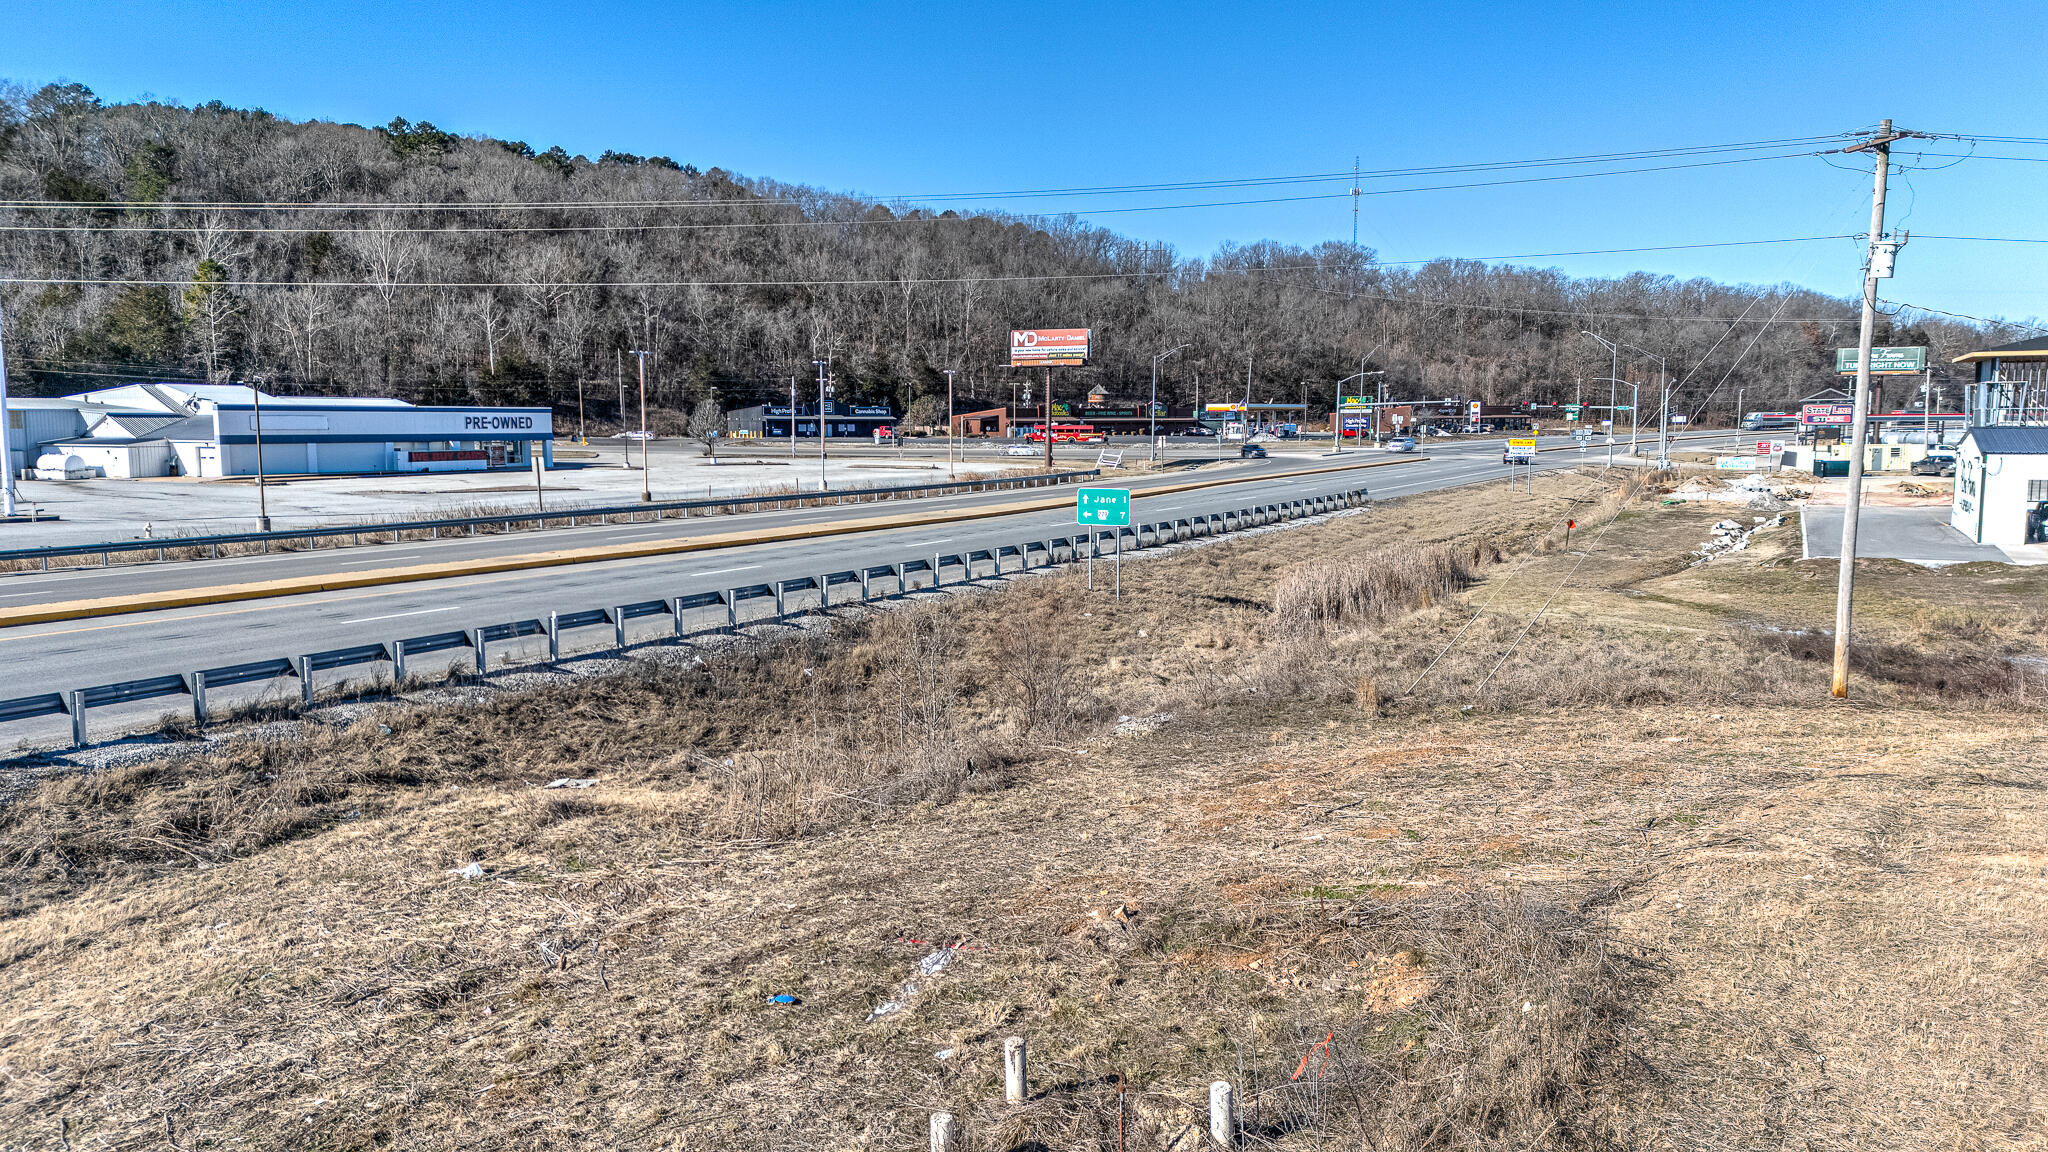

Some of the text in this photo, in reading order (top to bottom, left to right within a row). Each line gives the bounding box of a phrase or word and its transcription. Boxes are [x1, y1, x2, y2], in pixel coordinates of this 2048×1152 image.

[1013, 331, 1038, 347] MD
[465, 416, 533, 429] PRE-OWNED
[432, 451, 454, 461] BUY
[456, 450, 486, 460] CARS
